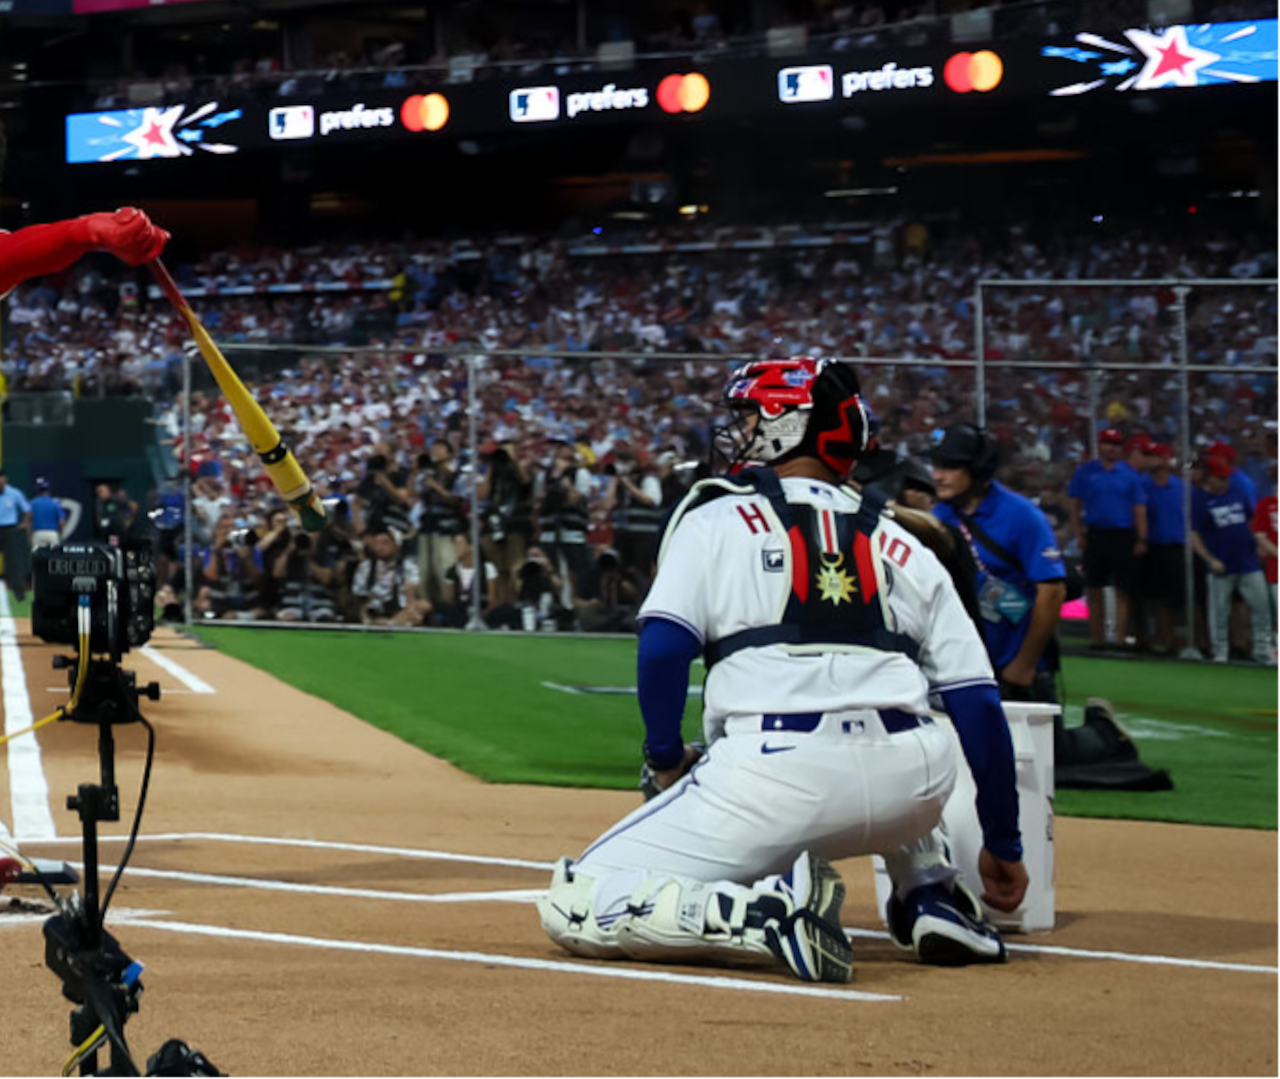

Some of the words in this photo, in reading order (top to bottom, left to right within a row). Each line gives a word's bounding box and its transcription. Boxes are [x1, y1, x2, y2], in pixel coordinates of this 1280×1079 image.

[842, 63, 933, 96] prefers
[567, 85, 648, 117] prefers
[320, 104, 393, 135] prefers
